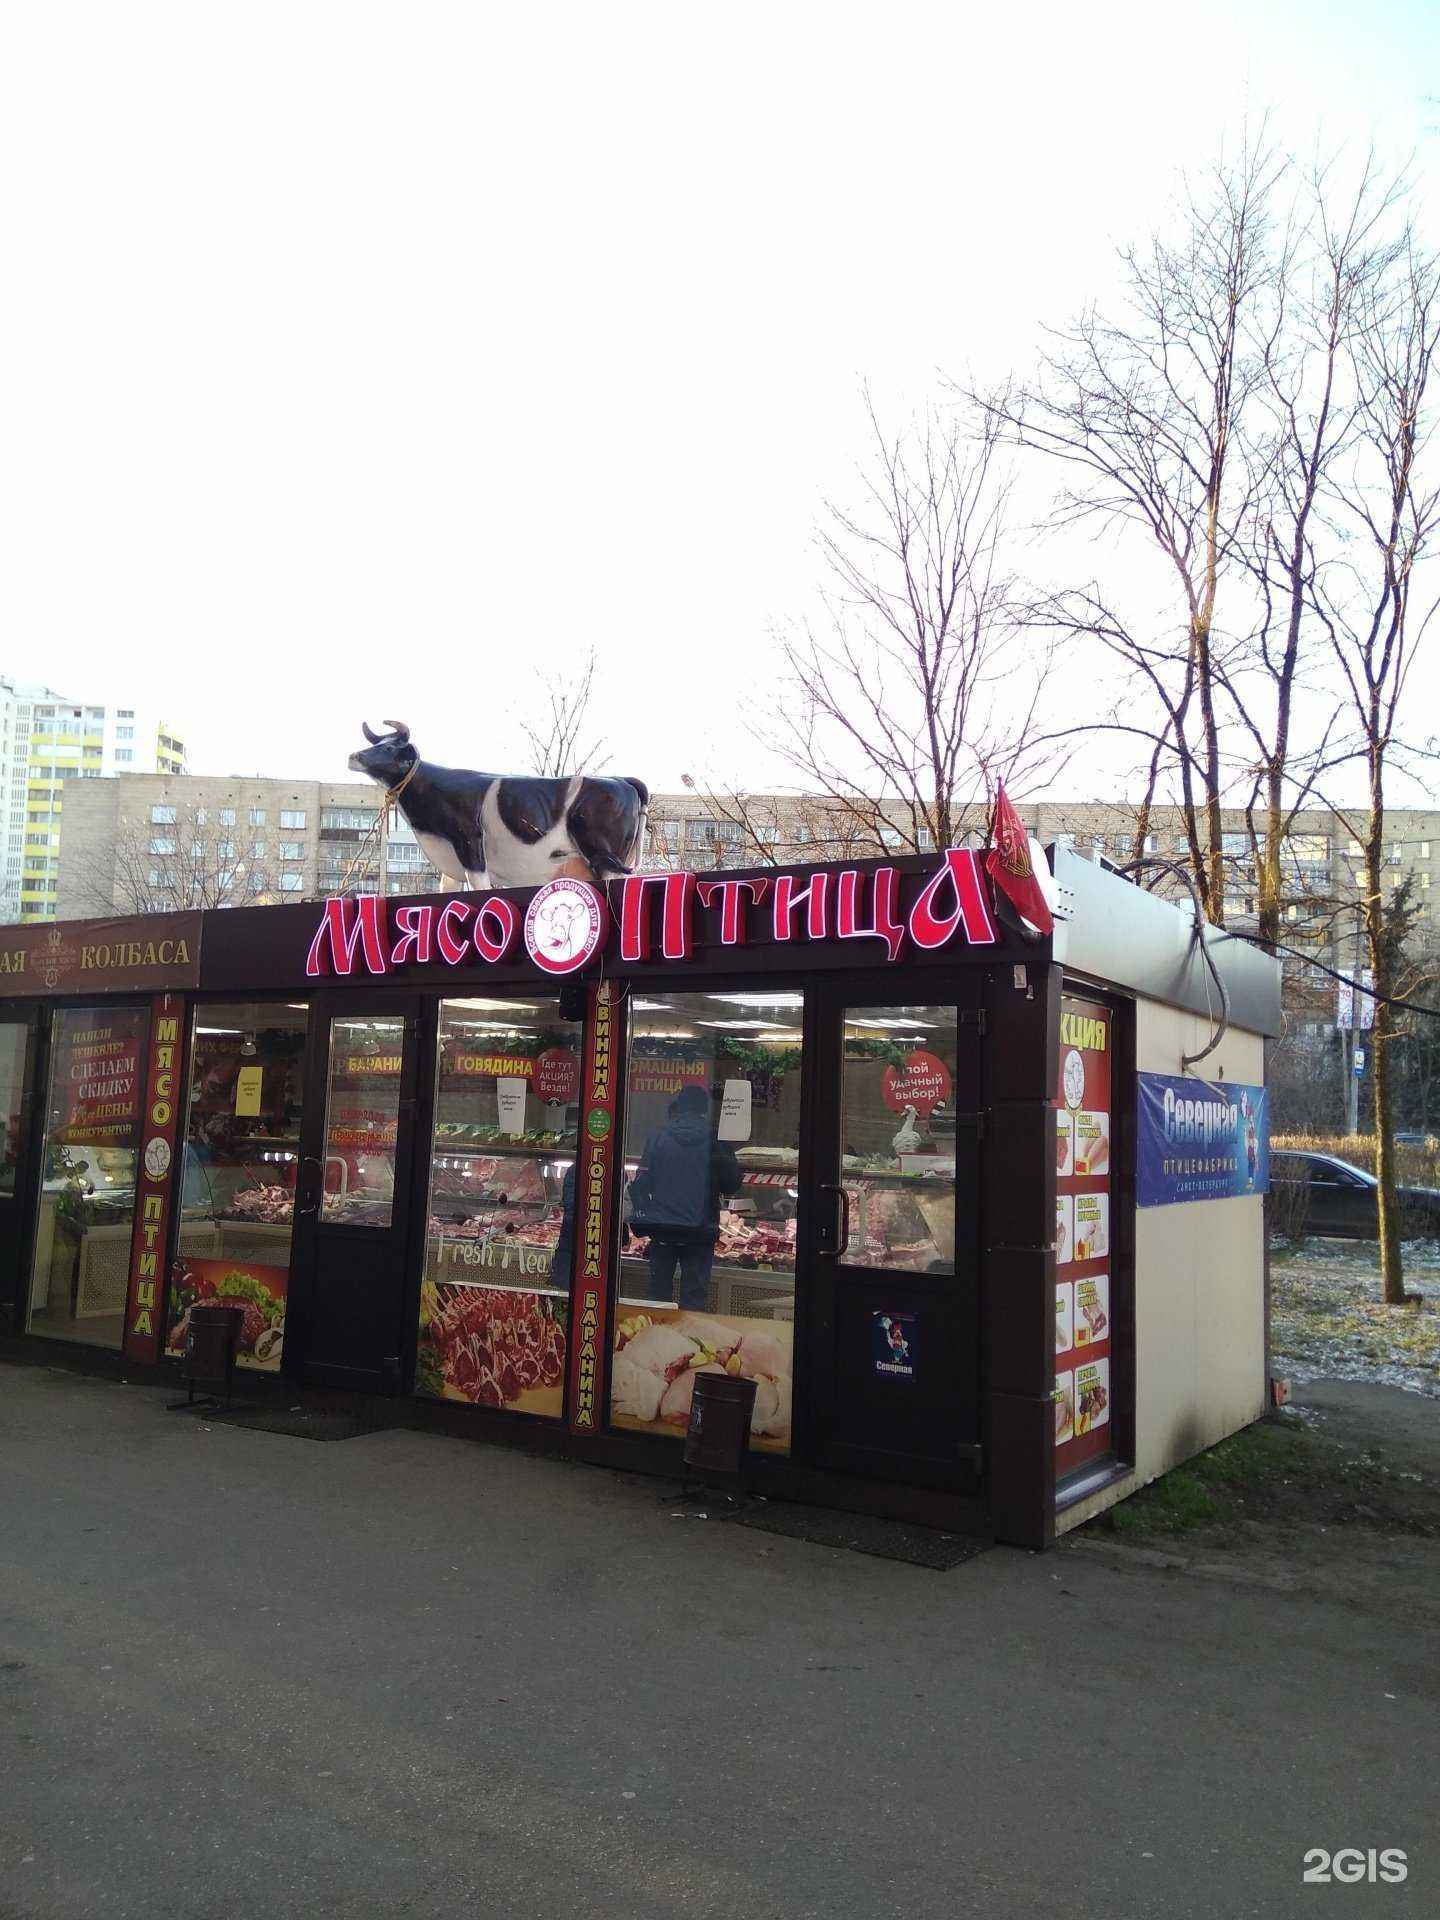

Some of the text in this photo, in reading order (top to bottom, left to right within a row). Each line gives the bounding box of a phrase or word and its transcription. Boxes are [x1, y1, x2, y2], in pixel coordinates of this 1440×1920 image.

[0, 950, 26, 974] АЯ
[80, 938, 191, 970] КОЛБАСА
[1060, 1012, 1106, 1051] КЦИЯ
[71, 1057, 136, 1081] СДЕЛАЕМ
[149, 1016, 178, 1127] МЯСО
[348, 1056, 402, 1073] БАРАНИ
[457, 1055, 533, 1076] ГОВЯДИНА
[79, 1078, 134, 1098] СКИДКУ
[895, 1086, 940, 1100] выбор!
[741, 1172, 799, 1187] ТИЦА
[132, 1194, 163, 1337] ПТИЦА
[575, 1290, 600, 1428] БАРАНИНА
